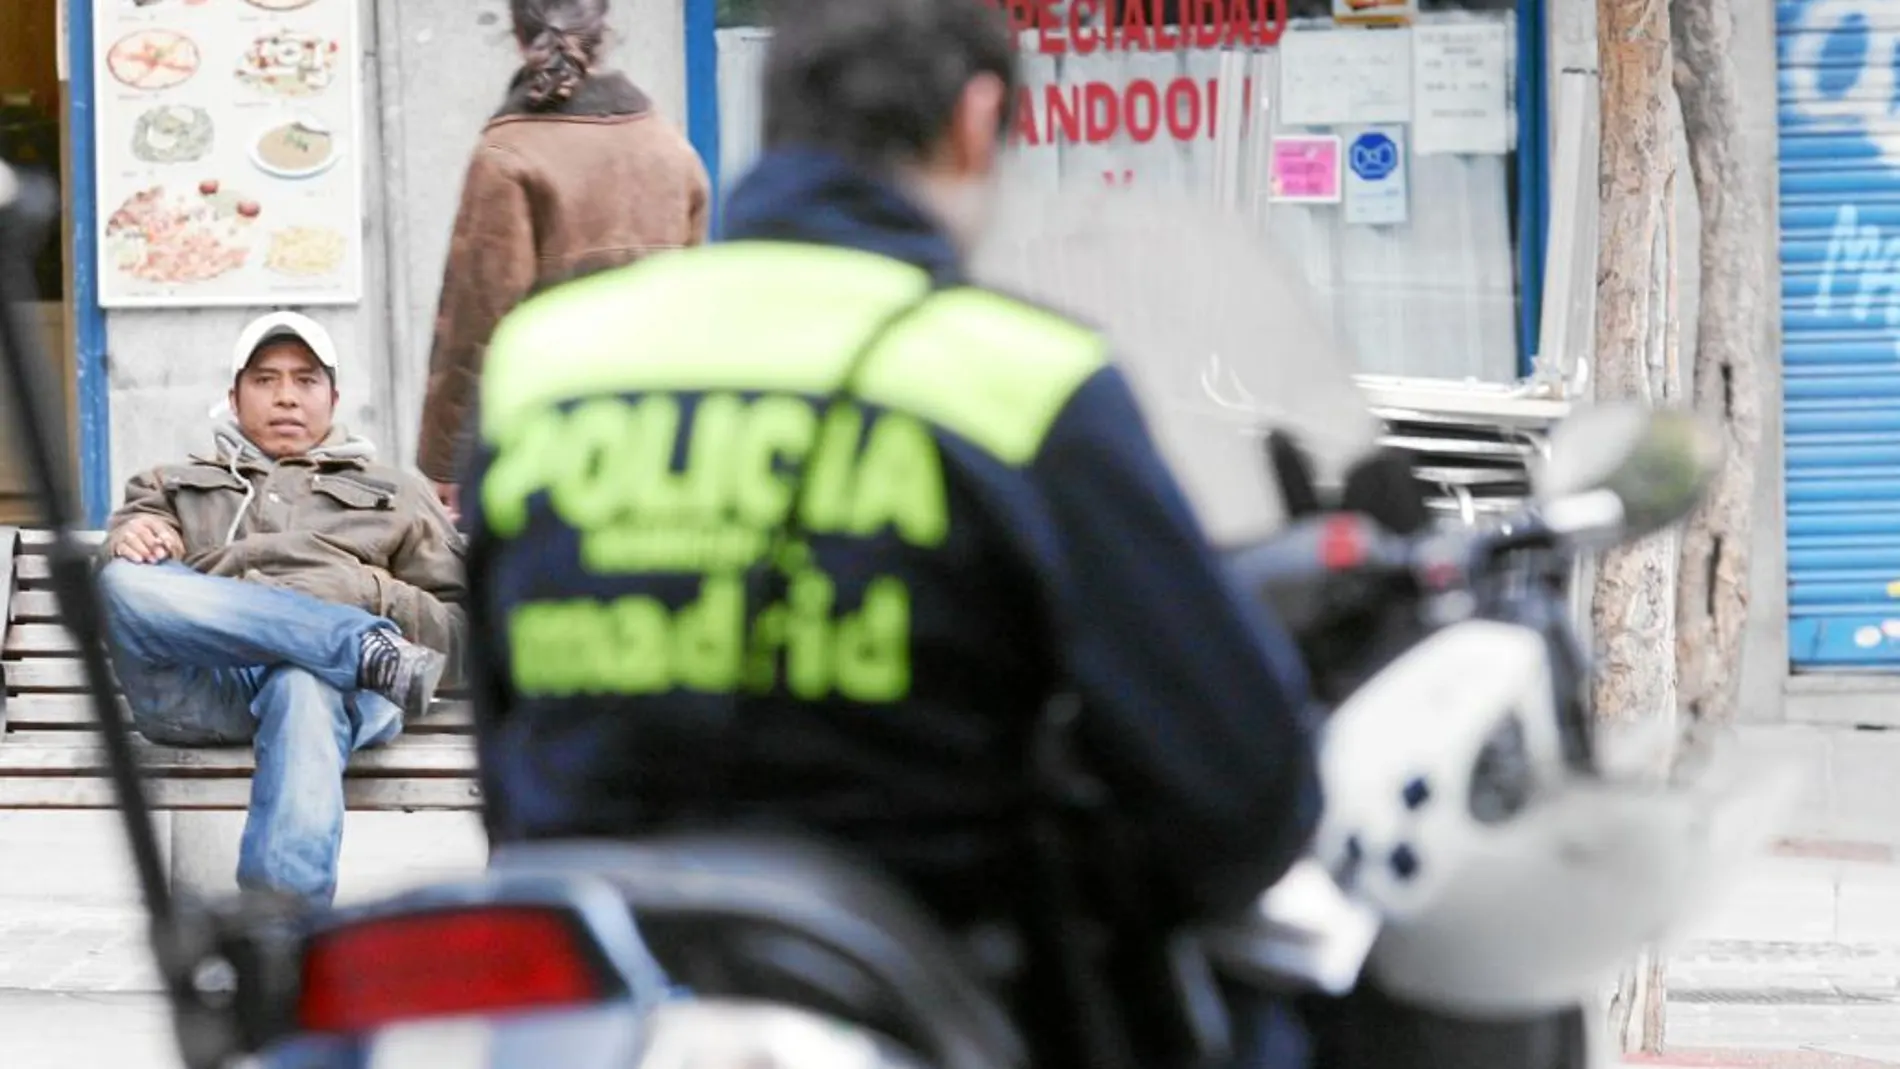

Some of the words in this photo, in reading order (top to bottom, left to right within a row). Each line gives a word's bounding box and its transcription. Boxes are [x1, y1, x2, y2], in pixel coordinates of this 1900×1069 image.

[986, 0, 1288, 54] PECIALIDAD
[482, 395, 949, 546] POLICIA
[510, 566, 911, 702] madrid
